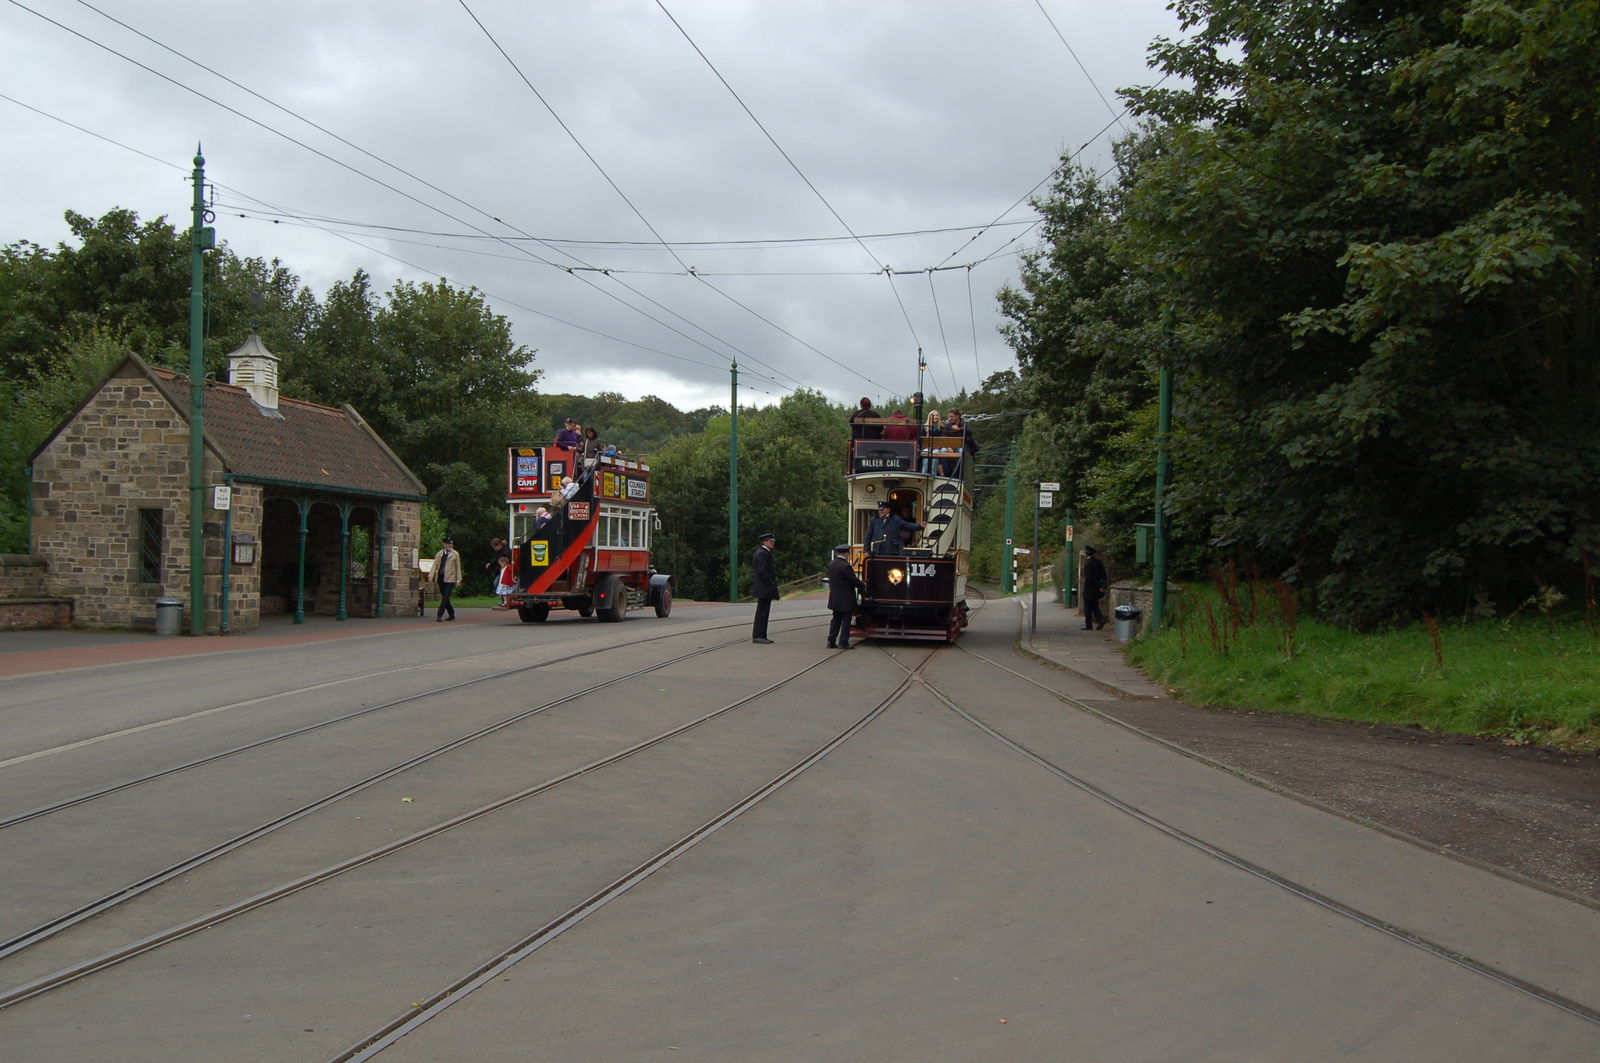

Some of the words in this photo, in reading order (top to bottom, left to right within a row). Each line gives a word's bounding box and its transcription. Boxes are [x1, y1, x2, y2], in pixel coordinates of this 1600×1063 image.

[862, 459, 883, 468] WALKER
[517, 479, 537, 487] CAMP
[911, 563, 936, 577] 114
